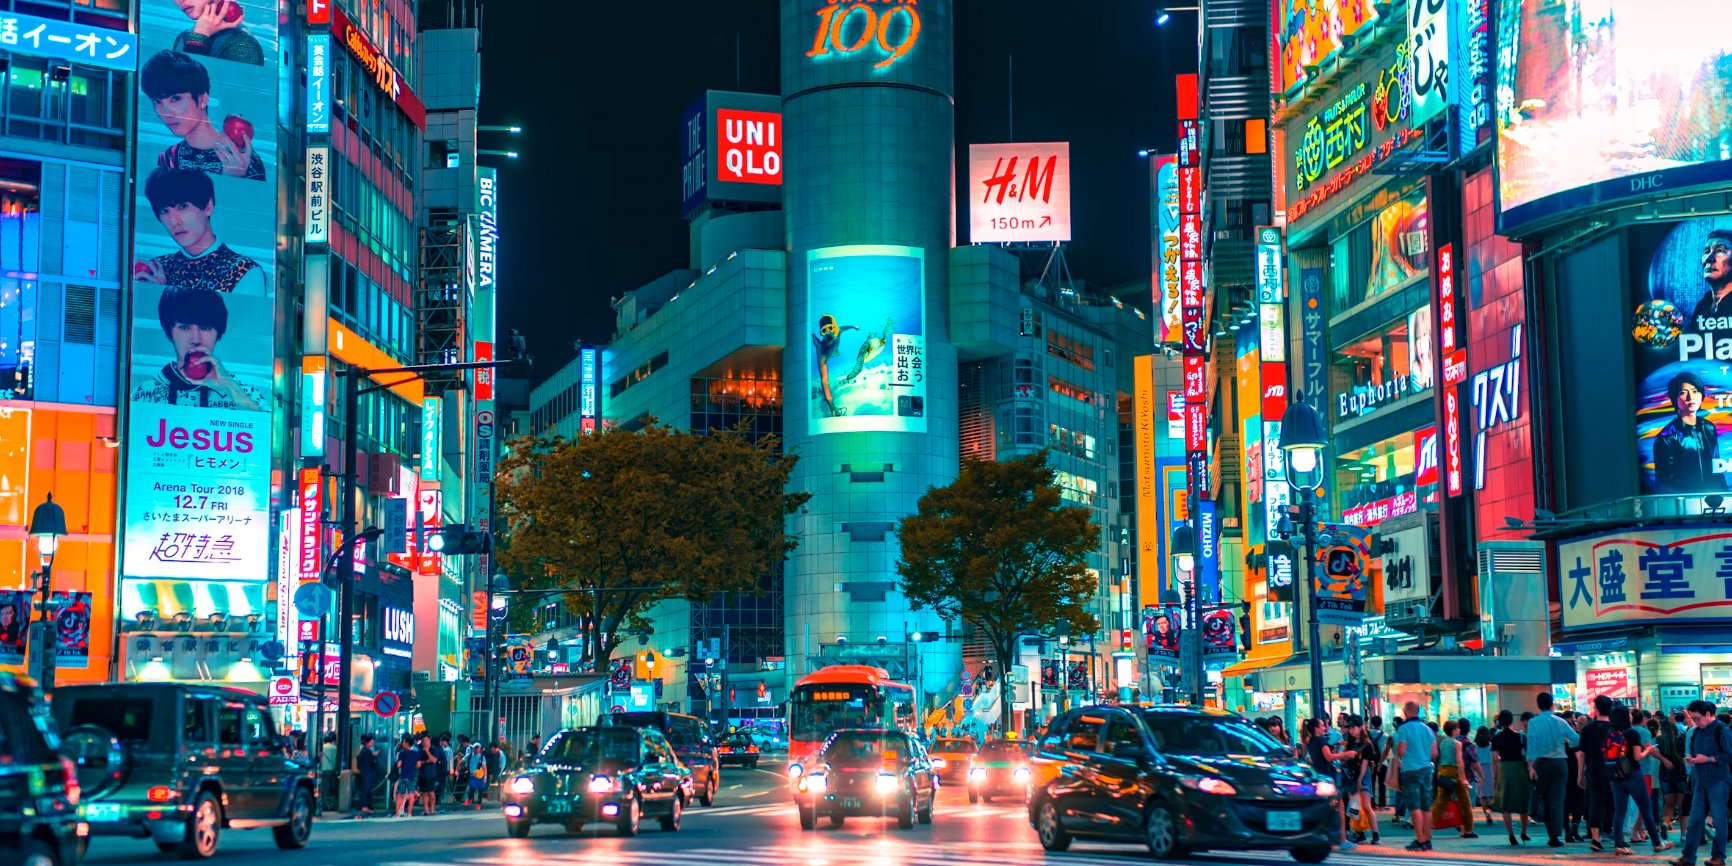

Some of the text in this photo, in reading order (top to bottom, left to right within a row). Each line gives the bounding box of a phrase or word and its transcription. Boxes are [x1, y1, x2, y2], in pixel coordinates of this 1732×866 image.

[805, 2, 921, 69] 109
[687, 112, 701, 157] THE
[725, 118, 775, 147] UNI
[1325, 102, 1366, 170] 西村
[683, 149, 706, 203] PRIME
[725, 147, 781, 178] QLO
[310, 153, 324, 234] 渋谷駅前ビル
[480, 177, 493, 207] BIC
[982, 154, 1058, 206] H&M
[1631, 174, 1663, 192] DHC
[990, 216, 1035, 230] 150m
[896, 344, 923, 356] 世界に
[1305, 311, 1325, 428] サマーフルー
[1264, 385, 1285, 398] JTB
[1339, 371, 1407, 417] Euphoria
[146, 418, 253, 454] Jesus
[209, 419, 253, 429] NEW SINGLE
[153, 481, 245, 496] Arena Tour 2018
[174, 494, 228, 511] 12.7 FRI
[143, 510, 253, 525] さいたまスーパーアリーナ
[149, 532, 242, 564] 超特急
[303, 499, 318, 572] サンドラッグ
[1202, 512, 1213, 558] MIZUHO
[384, 607, 414, 645] LUSH
